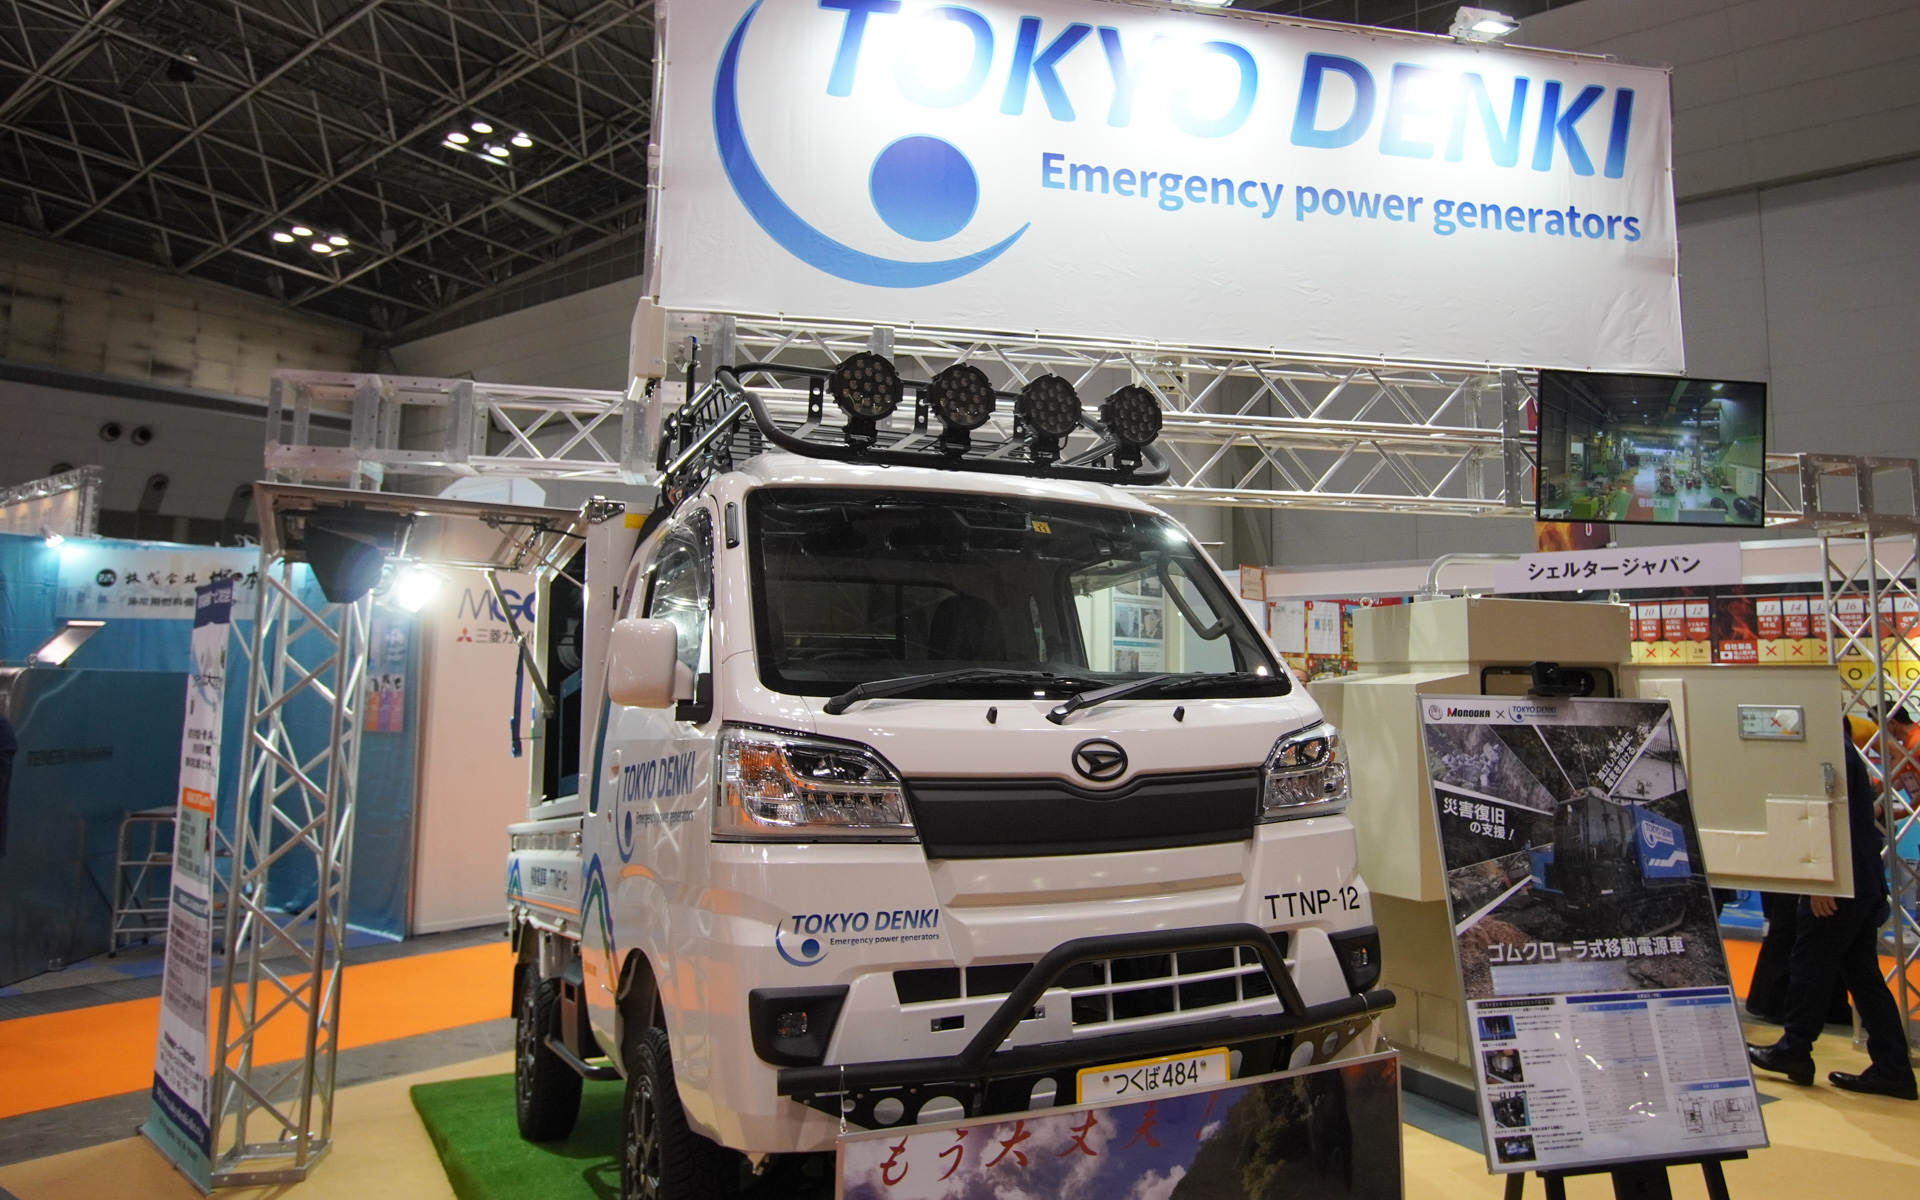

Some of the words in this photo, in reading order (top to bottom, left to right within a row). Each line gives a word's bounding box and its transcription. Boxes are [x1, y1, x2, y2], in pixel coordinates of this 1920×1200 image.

[817, 0, 1259, 139] TOKYO
[1290, 51, 1635, 180] DENKI
[1041, 152, 1284, 219] Emergency
[1295, 183, 1423, 223] power
[1433, 197, 1641, 242] generators
[125, 570, 197, 586] 株式会社
[1528, 556, 1700, 581] シェルタージャパン
[1645, 608, 1655, 616] 10
[1668, 608, 1678, 616] 11
[1692, 607, 1703, 615] 12
[1763, 604, 1775, 612] 13
[1512, 706, 1534, 714] TOKYO
[623, 759, 656, 802] TOKYO
[657, 750, 696, 798] DENKI
[1443, 797, 1505, 825] 災害復旧
[1264, 886, 1360, 919] TTNP-12
[792, 912, 869, 934] TOKYO
[874, 909, 939, 931] DENKI
[830, 938, 873, 946] Emergency
[875, 936, 899, 945] power
[901, 933, 940, 943] generators
[1488, 936, 1685, 962] ゴムクローラ式移動電源車
[1114, 1060, 1198, 1094] つくば484
